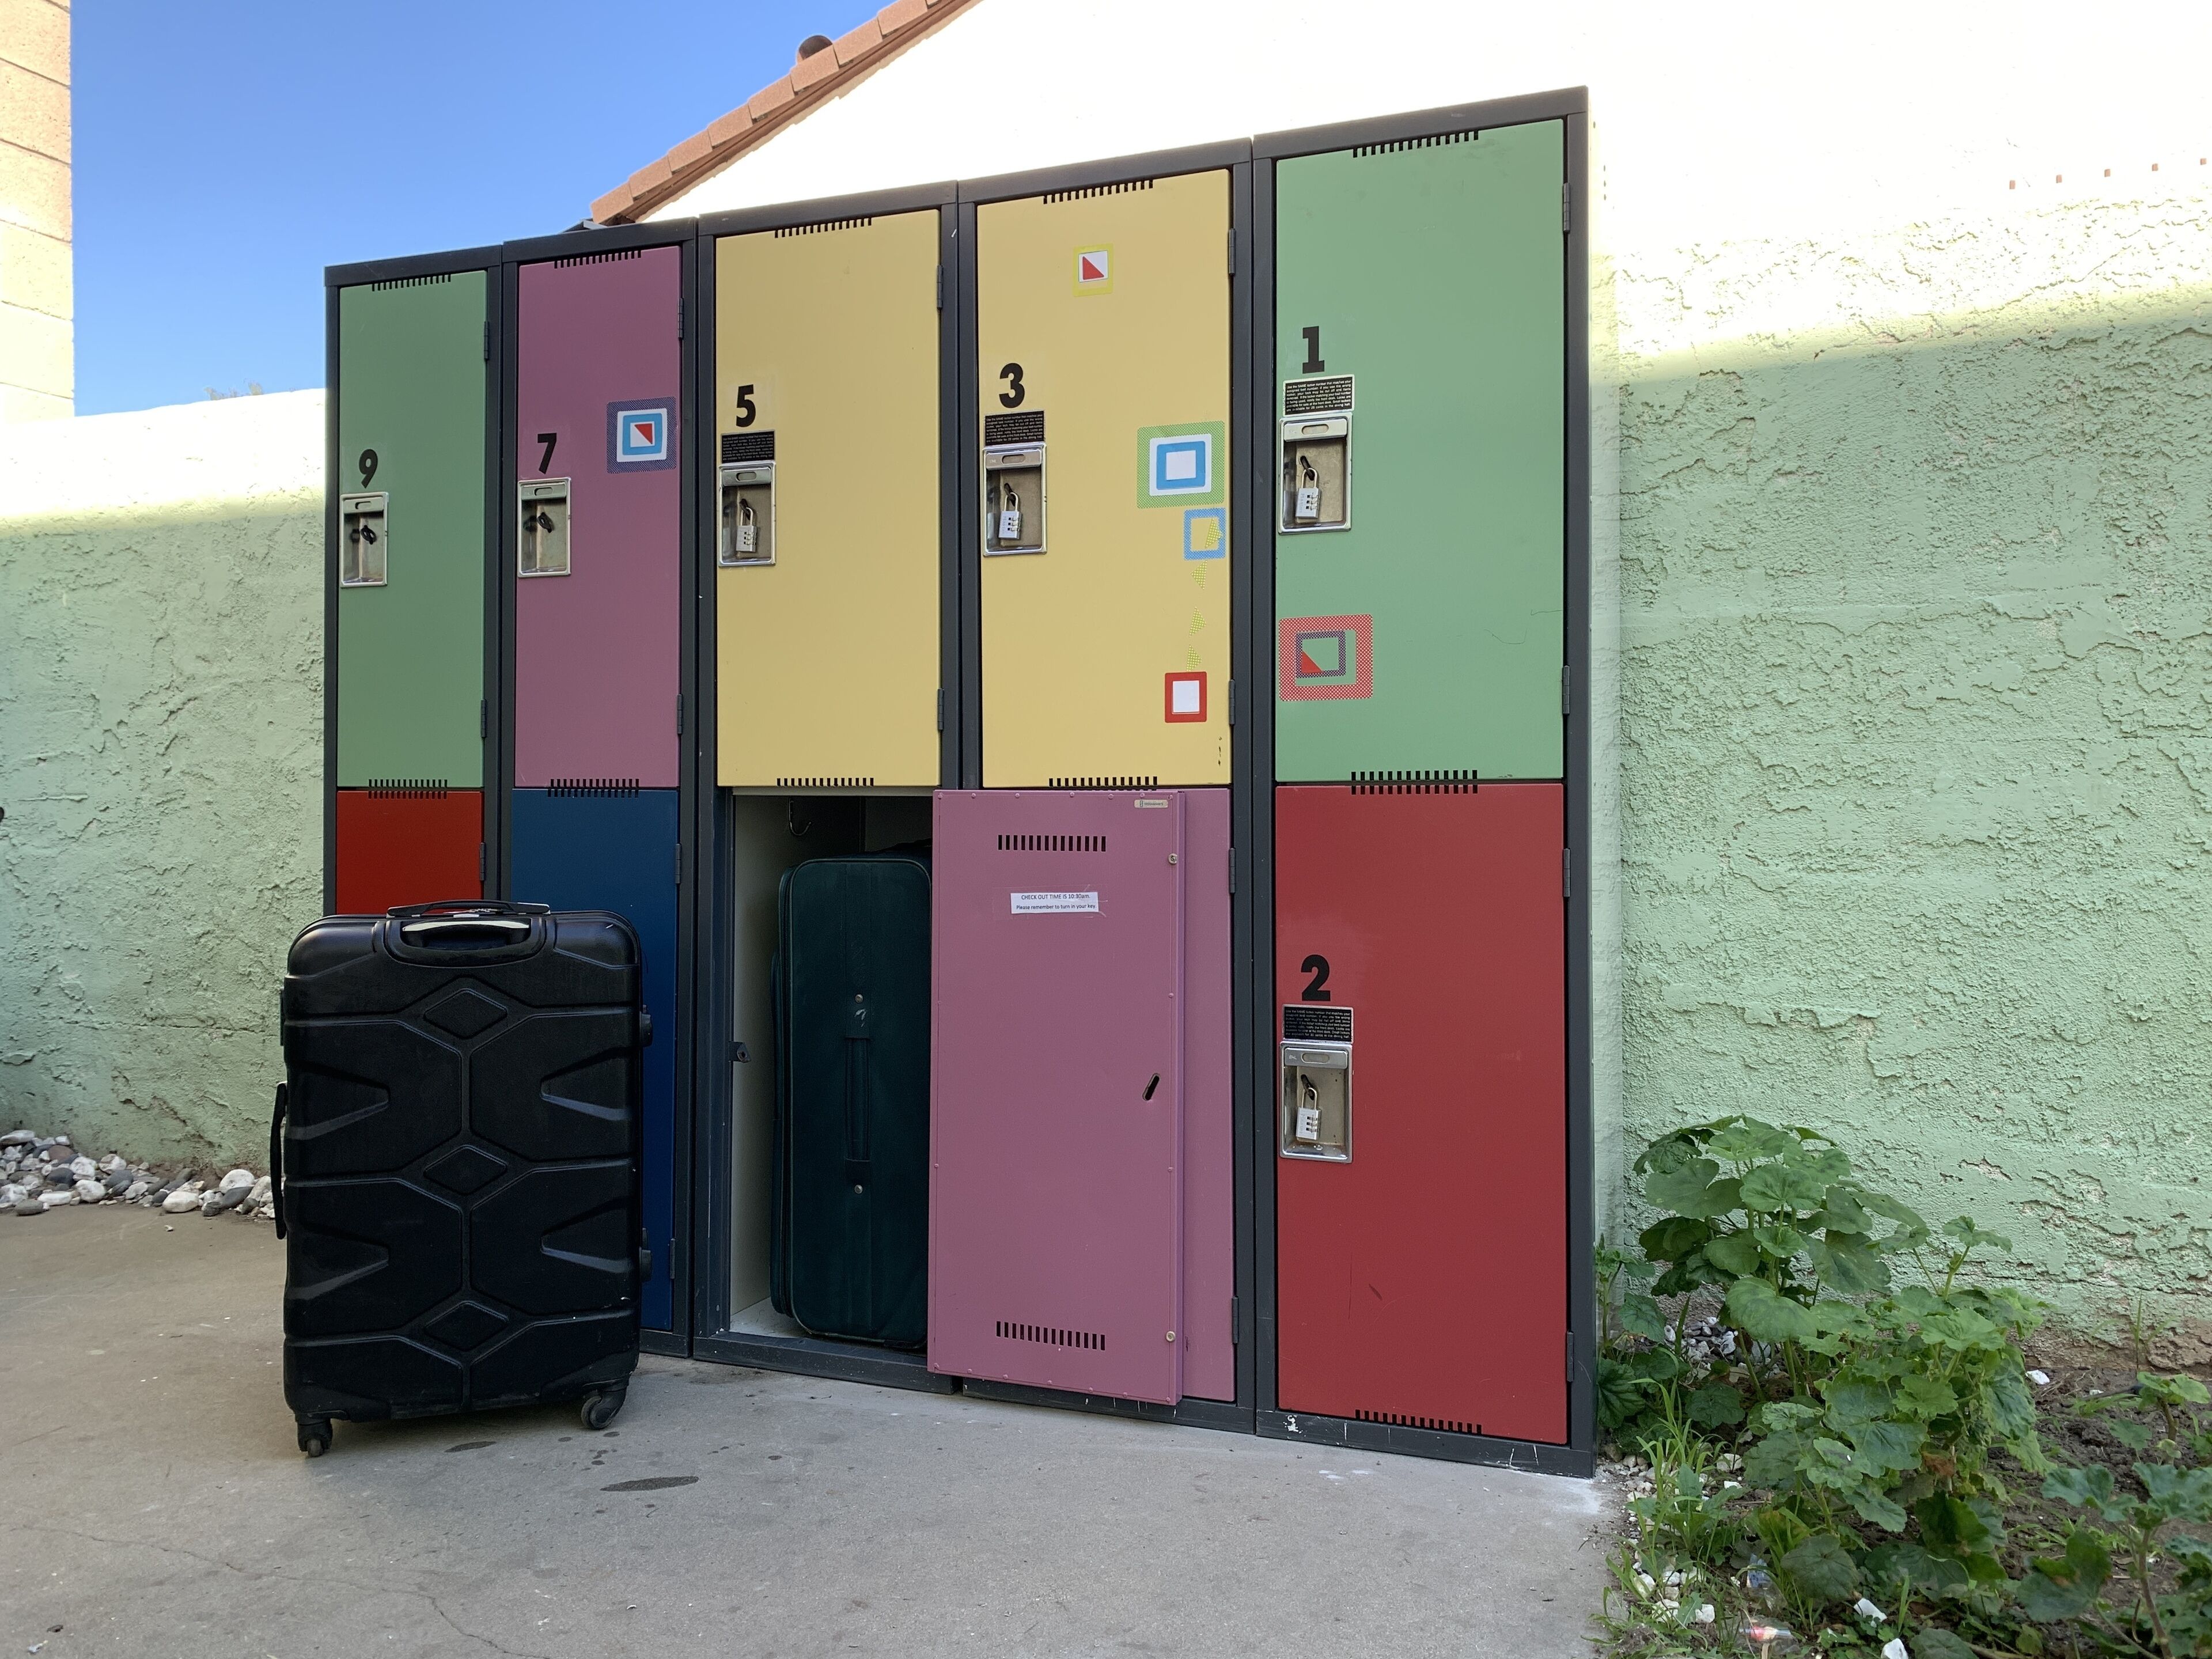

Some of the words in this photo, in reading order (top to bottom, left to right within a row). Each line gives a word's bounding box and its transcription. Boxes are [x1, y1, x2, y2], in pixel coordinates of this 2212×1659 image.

[1302, 326, 1324, 374] 1
[736, 384, 756, 427] 5
[999, 363, 1025, 408] 3
[359, 449, 378, 488] 9
[537, 433, 557, 474] 7
[1301, 955, 1331, 1001] 2
